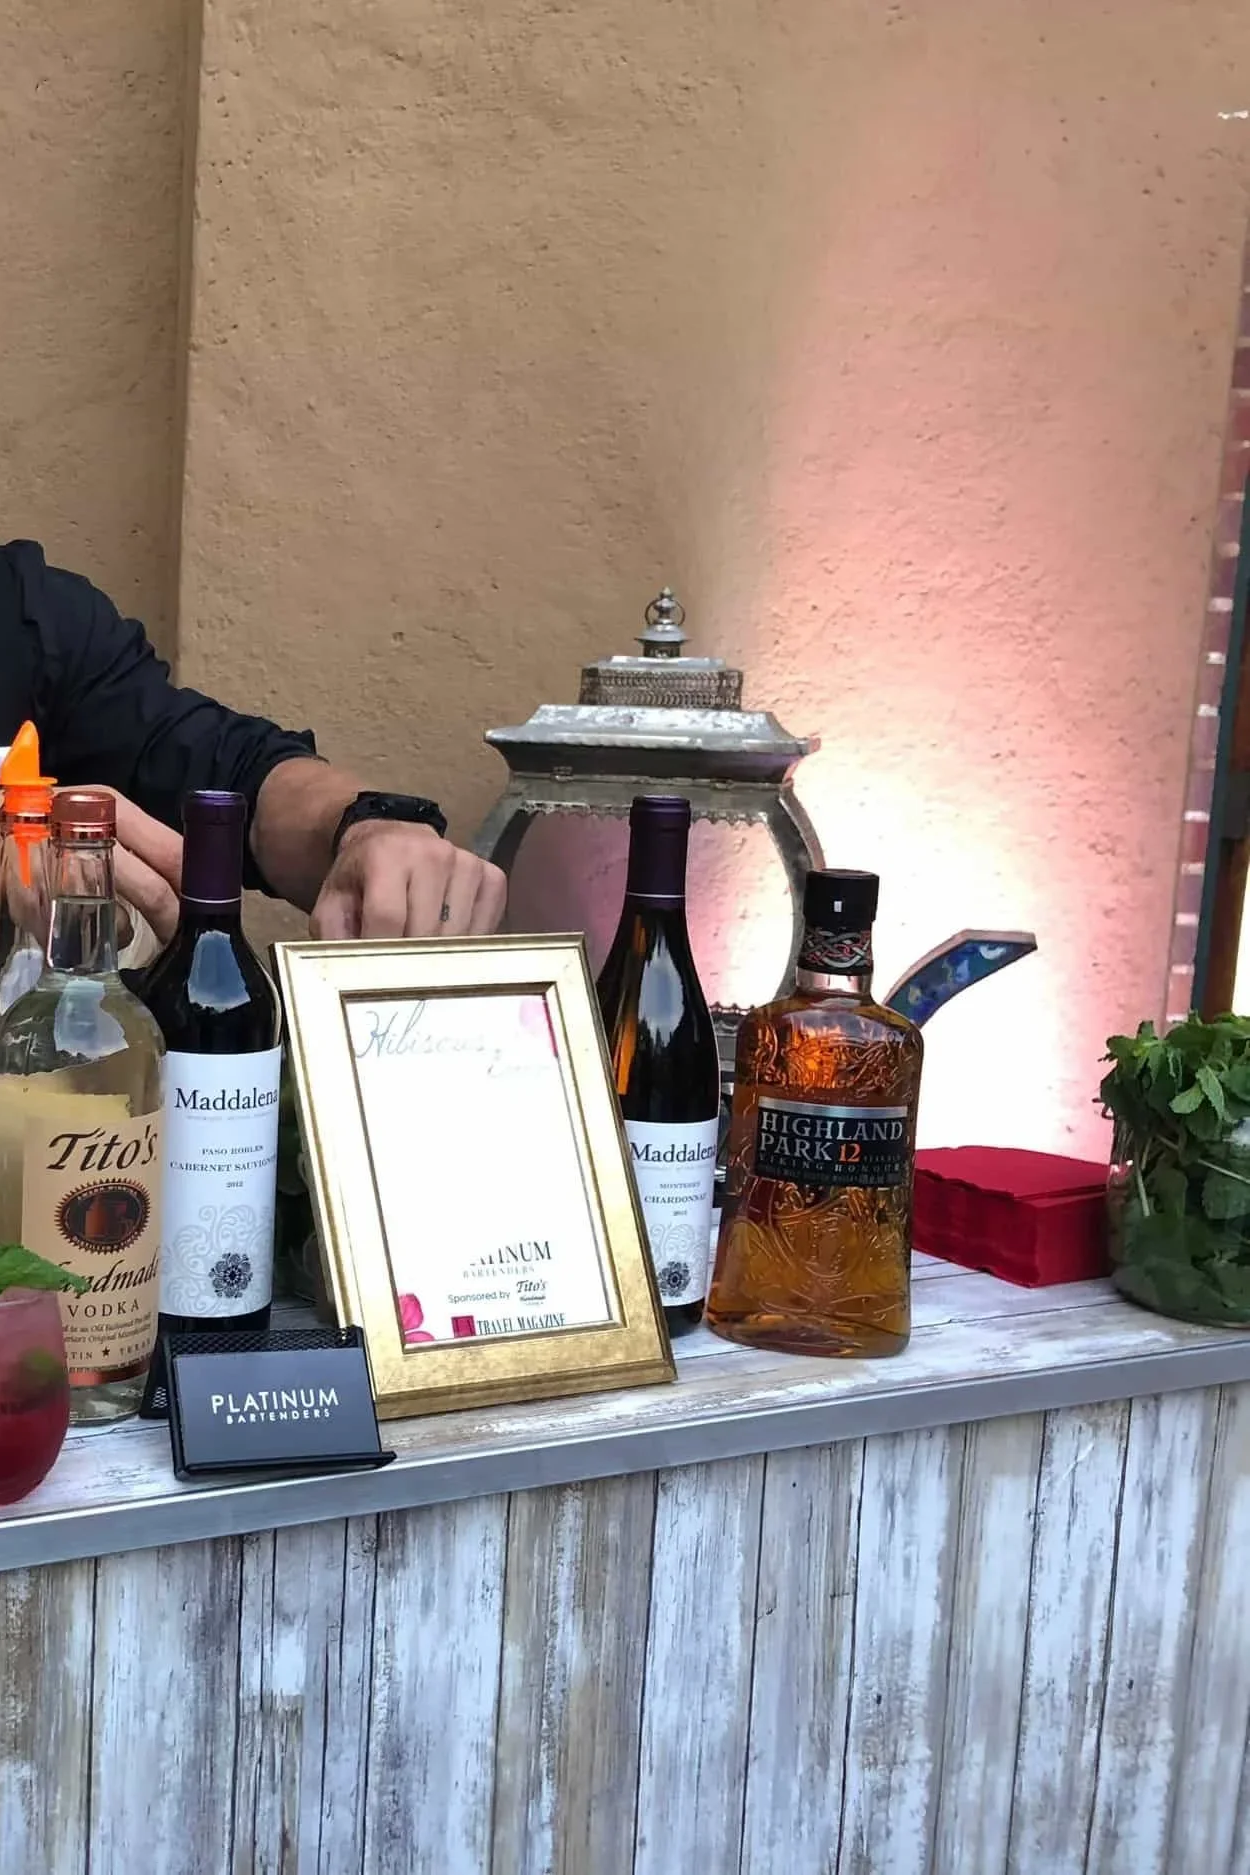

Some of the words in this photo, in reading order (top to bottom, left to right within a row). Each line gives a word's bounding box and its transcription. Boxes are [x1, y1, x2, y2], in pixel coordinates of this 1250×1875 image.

[174, 1087, 278, 1111] Maddalena
[761, 1111, 903, 1141] HIGHLAND
[46, 1124, 158, 1172] Tito's
[760, 1133, 833, 1162] PARK
[840, 1143, 863, 1163] 12
[170, 1160, 232, 1173] CABERNET
[448, 1290, 497, 1304] Sponsored
[499, 1289, 510, 1301] by
[516, 1279, 548, 1294] Tito's
[67, 1298, 139, 1319] VODKA
[477, 1317, 515, 1336] TRAVEL
[516, 1312, 566, 1331] MAGAZINE
[211, 1387, 340, 1415] PLATINUM
[226, 1408, 330, 1425] BARTENDERS
